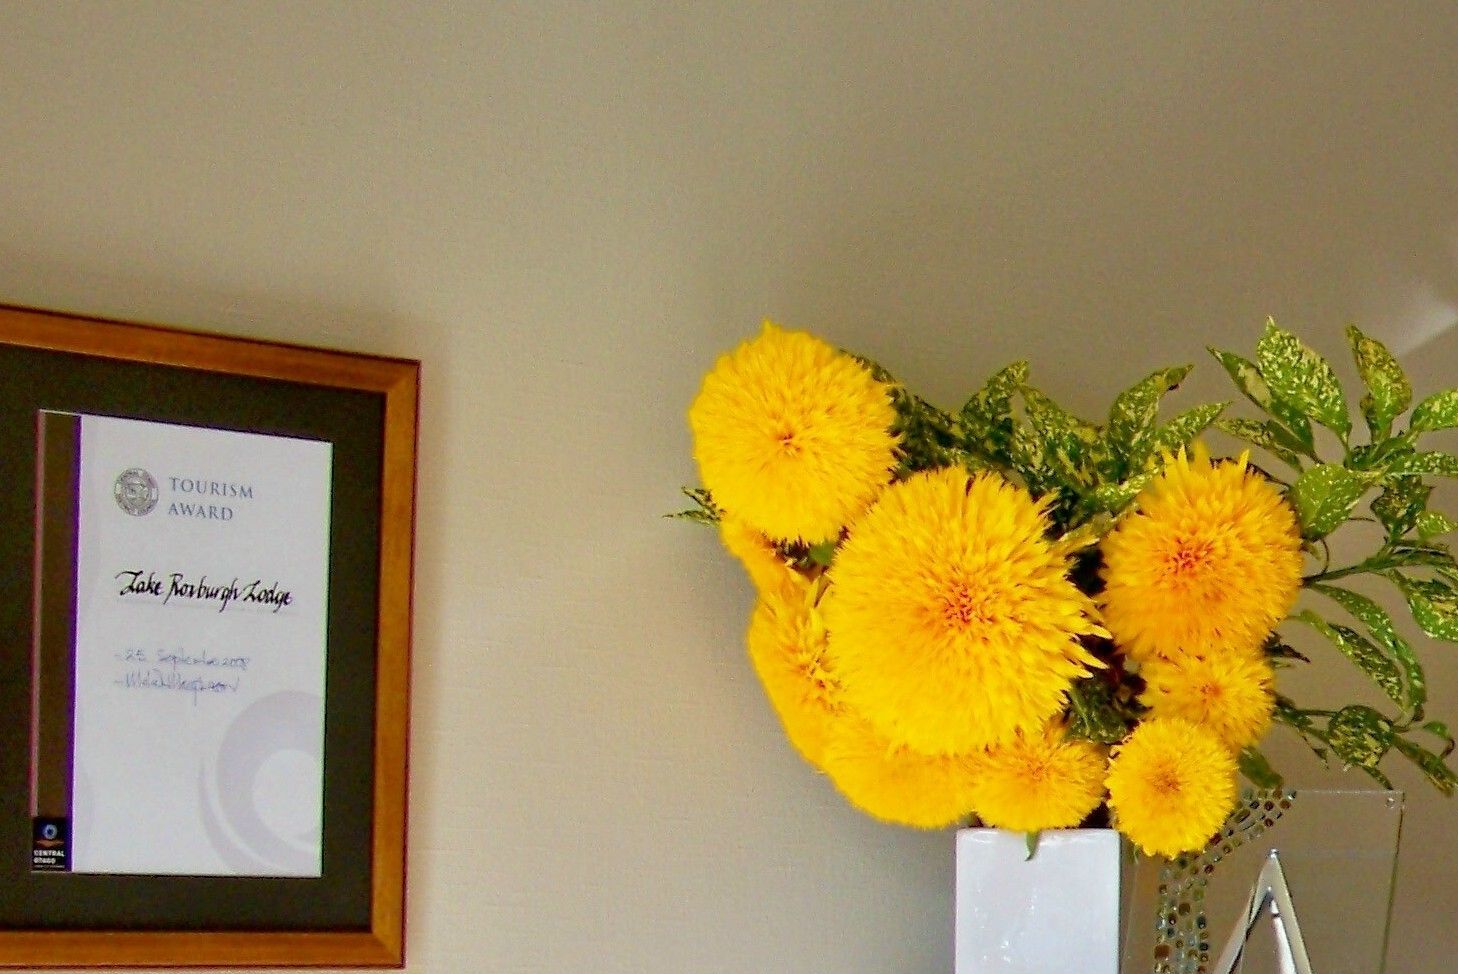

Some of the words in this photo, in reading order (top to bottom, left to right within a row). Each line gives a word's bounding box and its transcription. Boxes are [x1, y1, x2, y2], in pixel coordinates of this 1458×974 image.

[168, 476, 254, 499] TOURISM
[168, 502, 234, 521] AWARD
[114, 570, 164, 596] Lake
[163, 573, 239, 613] Roxburgh
[242, 579, 294, 613] Lodge
